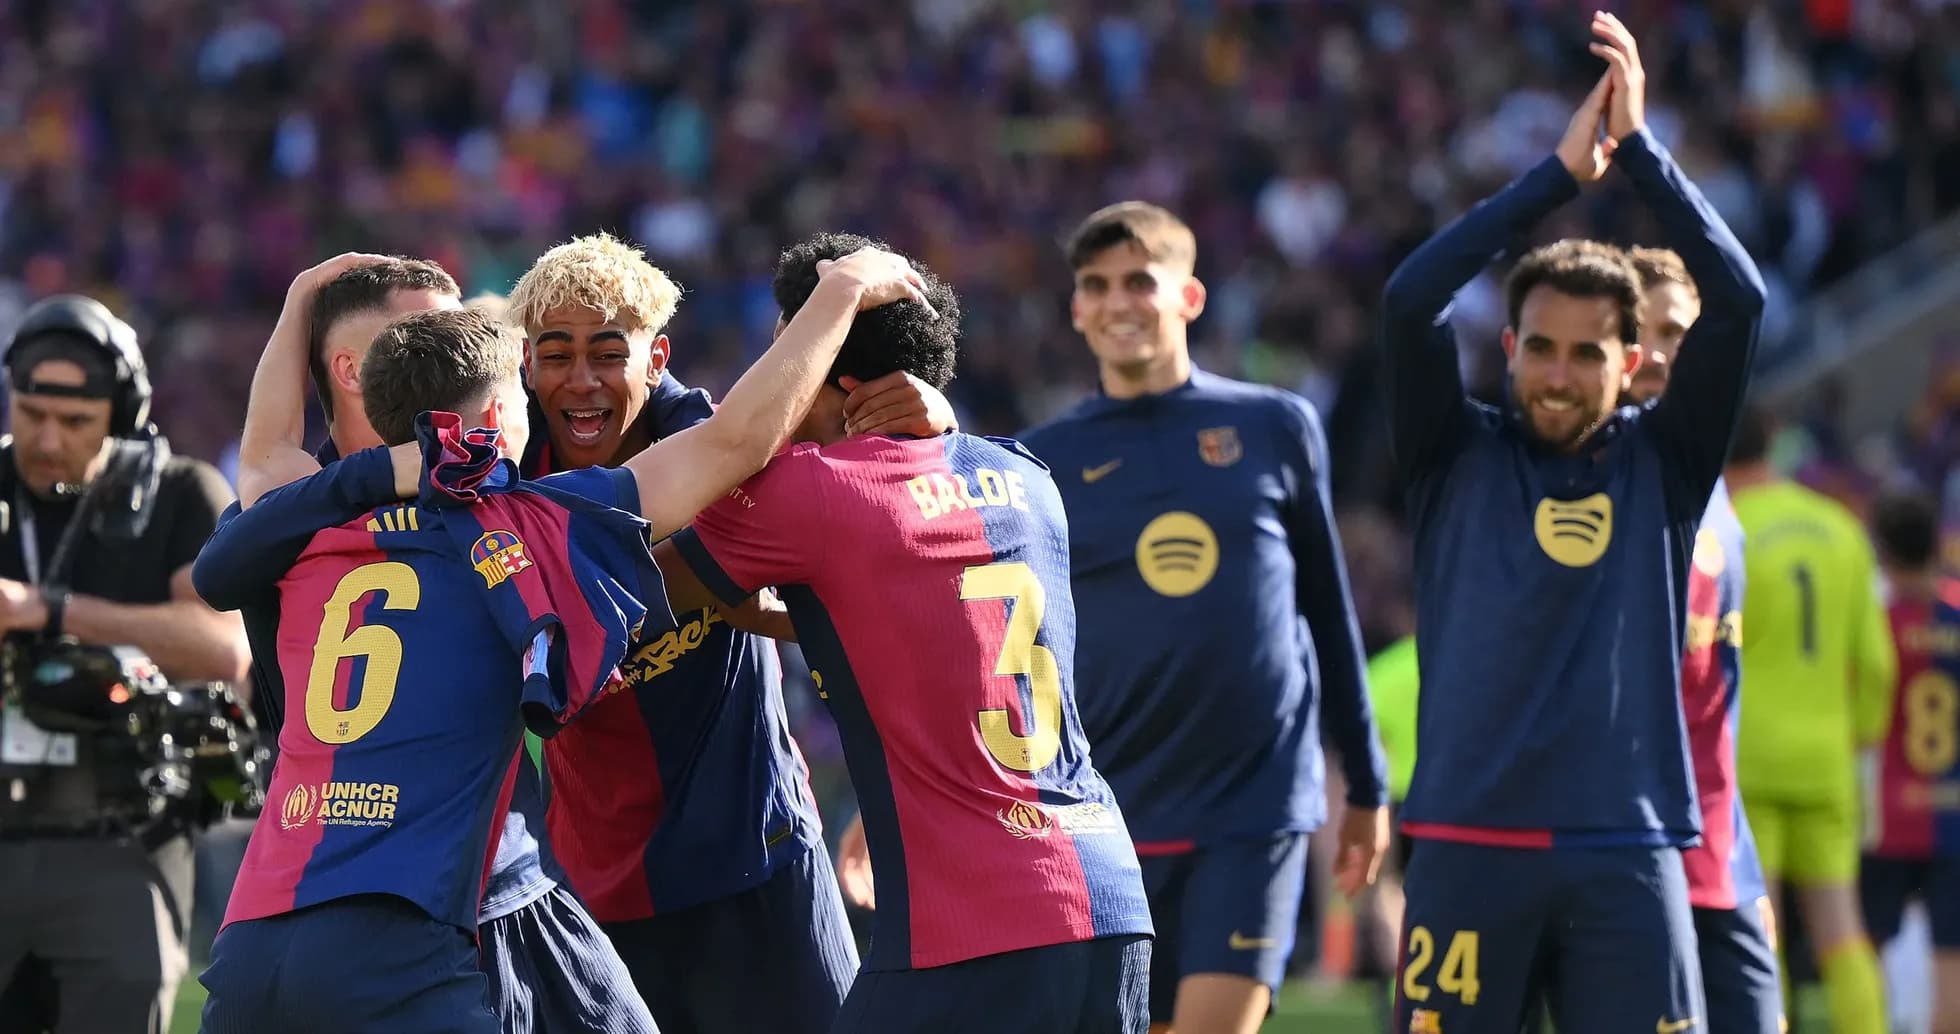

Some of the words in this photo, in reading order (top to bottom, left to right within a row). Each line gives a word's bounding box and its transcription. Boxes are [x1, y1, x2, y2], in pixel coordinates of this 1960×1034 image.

[906, 468, 1030, 520] BALDE
[1792, 559, 1817, 662] 1
[305, 561, 421, 744] 6
[959, 561, 1061, 771] 3
[1905, 670, 1959, 776] 8
[317, 800, 396, 819] ACNUR
[321, 782, 399, 802] UNHCR
[339, 819, 366, 827] Refugee
[367, 820, 392, 828] Agency
[1403, 926, 1480, 1006] 24
